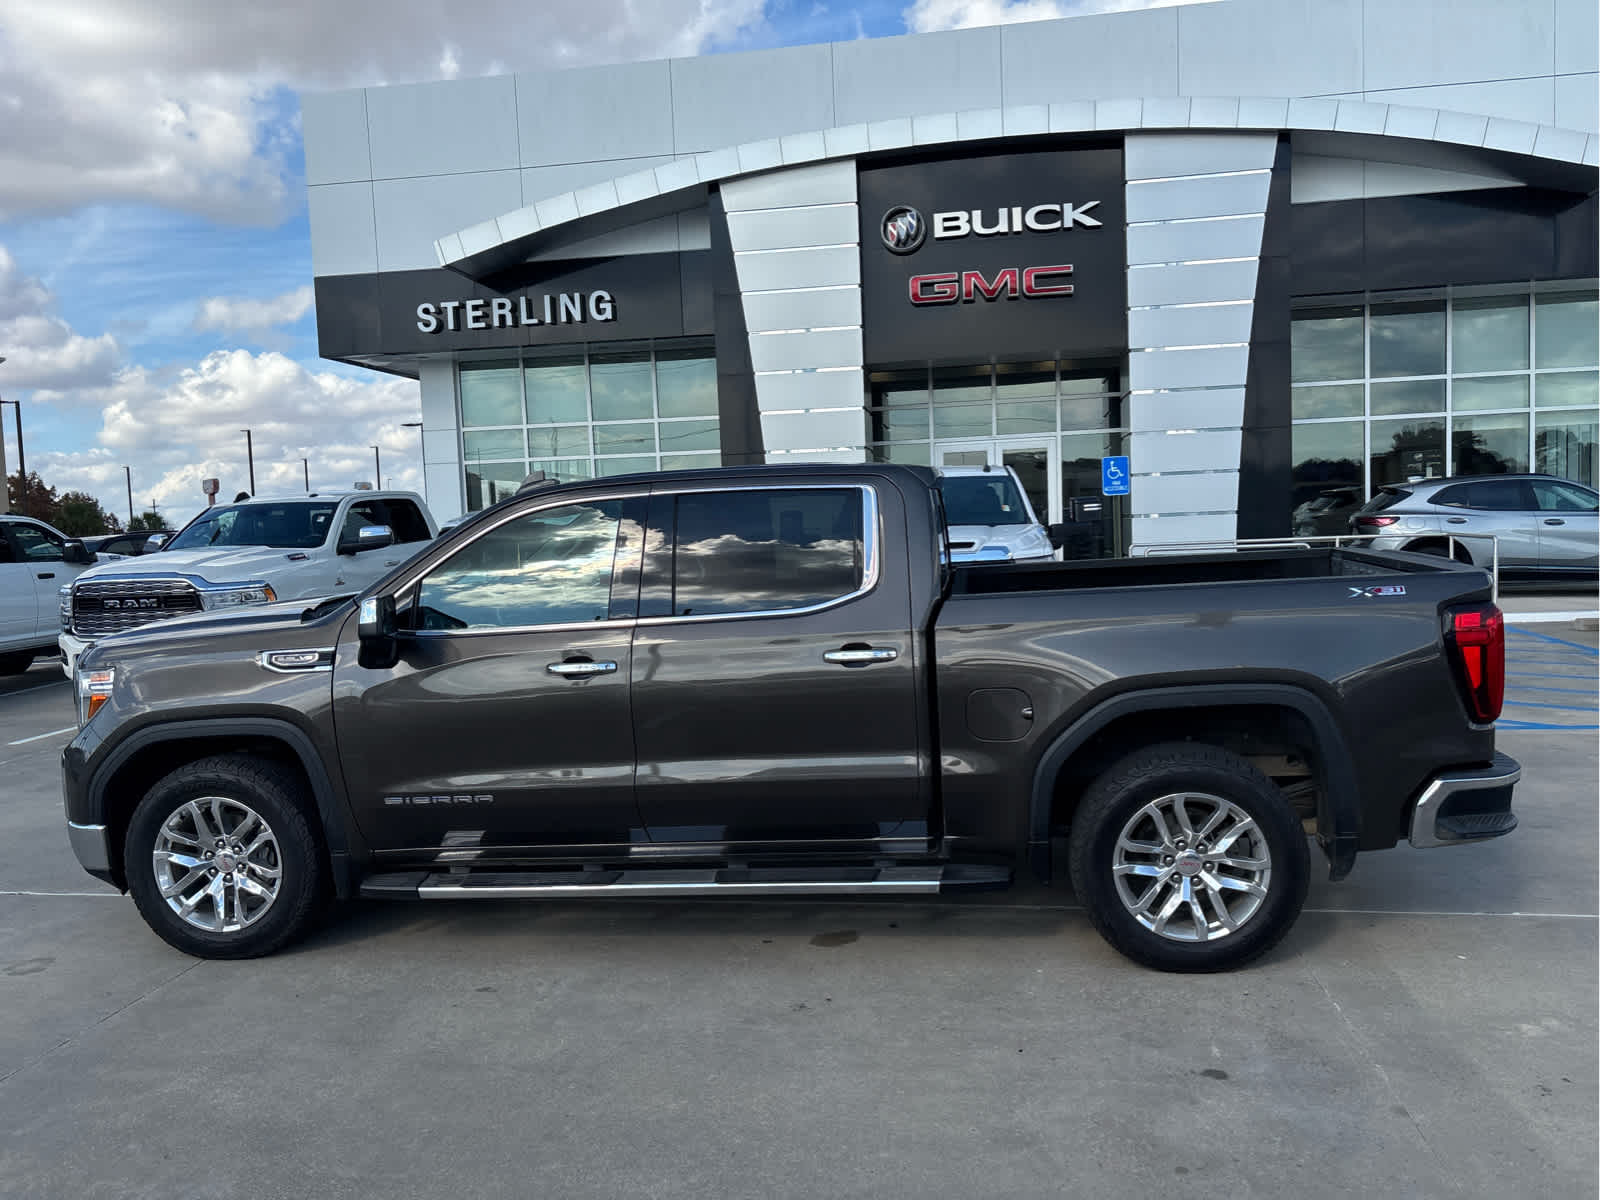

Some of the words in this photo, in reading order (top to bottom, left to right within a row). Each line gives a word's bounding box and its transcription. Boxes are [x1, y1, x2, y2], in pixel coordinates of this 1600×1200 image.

[933, 200, 1103, 238] BUICK
[909, 264, 1074, 304] GMC
[416, 290, 613, 333] STERLING
[103, 598, 158, 609] RAM
[383, 794, 494, 805] SIERRA
